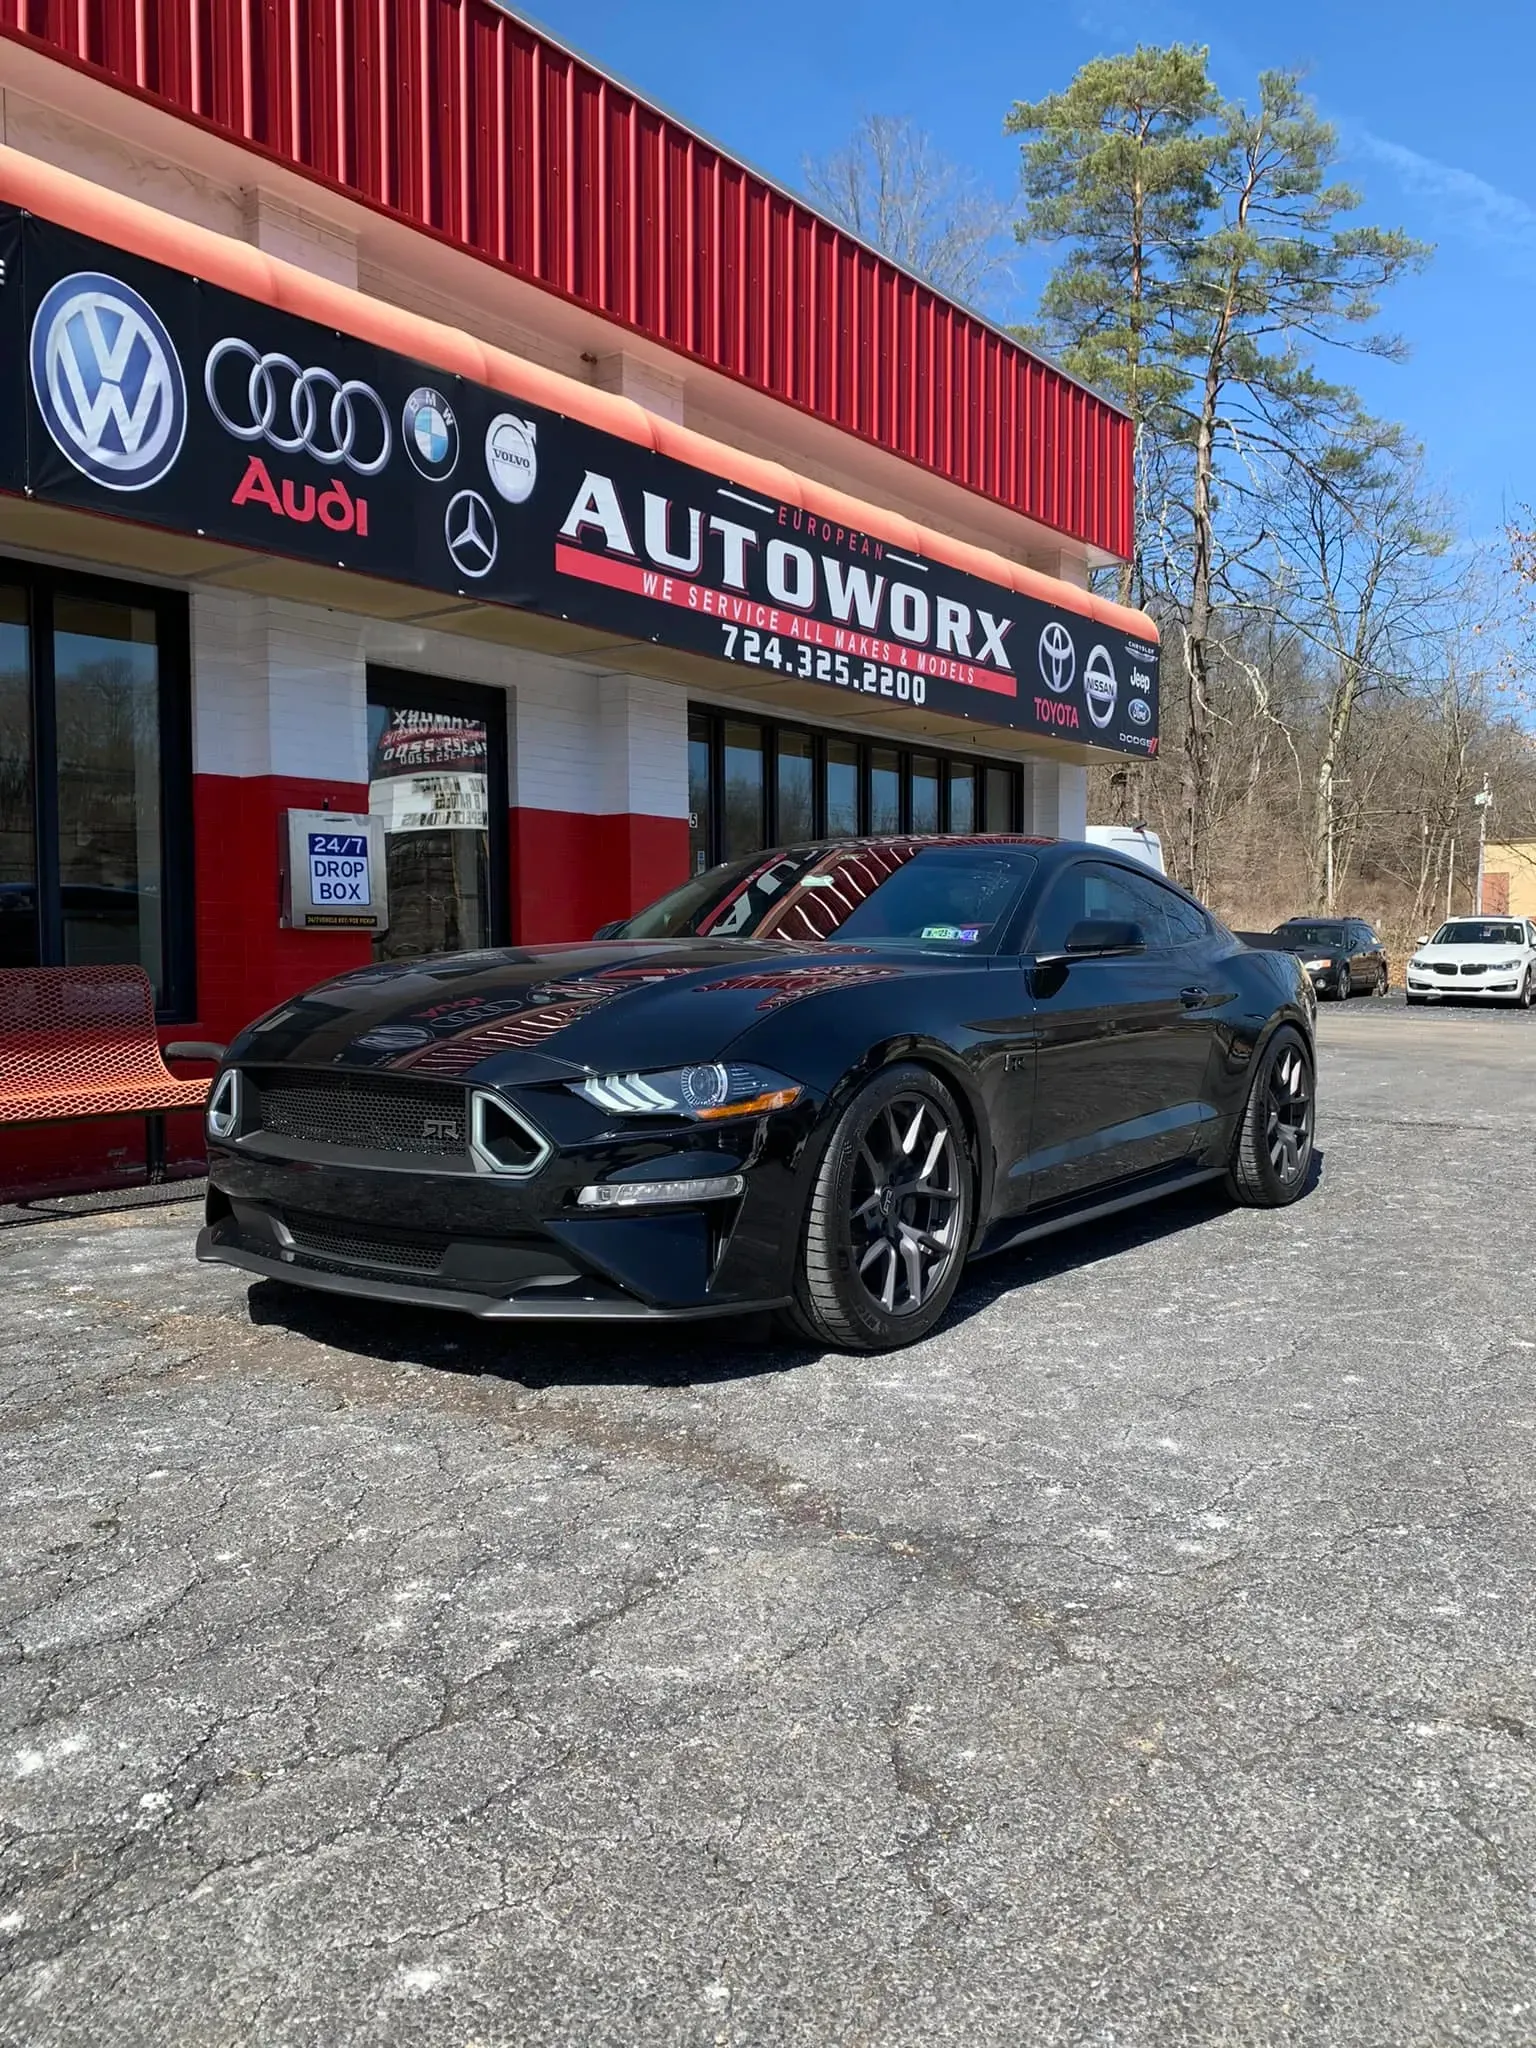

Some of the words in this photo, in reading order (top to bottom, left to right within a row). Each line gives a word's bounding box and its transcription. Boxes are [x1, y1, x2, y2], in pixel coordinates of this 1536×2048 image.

[409, 390, 454, 426] BMW
[492, 447, 530, 469] VOLVO
[231, 455, 369, 537] Audi
[777, 505, 883, 561] EUROPEAN
[557, 469, 1015, 672] AUTOWORX
[643, 572, 673, 601] WE
[688, 586, 779, 630] SERVICE
[790, 617, 823, 643] ALL
[835, 629, 890, 662] MAKES
[900, 648, 908, 666] &
[917, 653, 975, 684] MODELS
[1128, 641, 1154, 654] CHRYSLER
[722, 623, 926, 704] 724.325.2200
[1086, 677, 1114, 697] NISSAN
[1130, 666, 1150, 694] Jeep
[1034, 697, 1080, 729] TOYOTA
[1119, 732, 1152, 747] DODGE
[314, 836, 363, 854] 24/7
[314, 860, 364, 878] DROP
[320, 883, 361, 900] BOX
